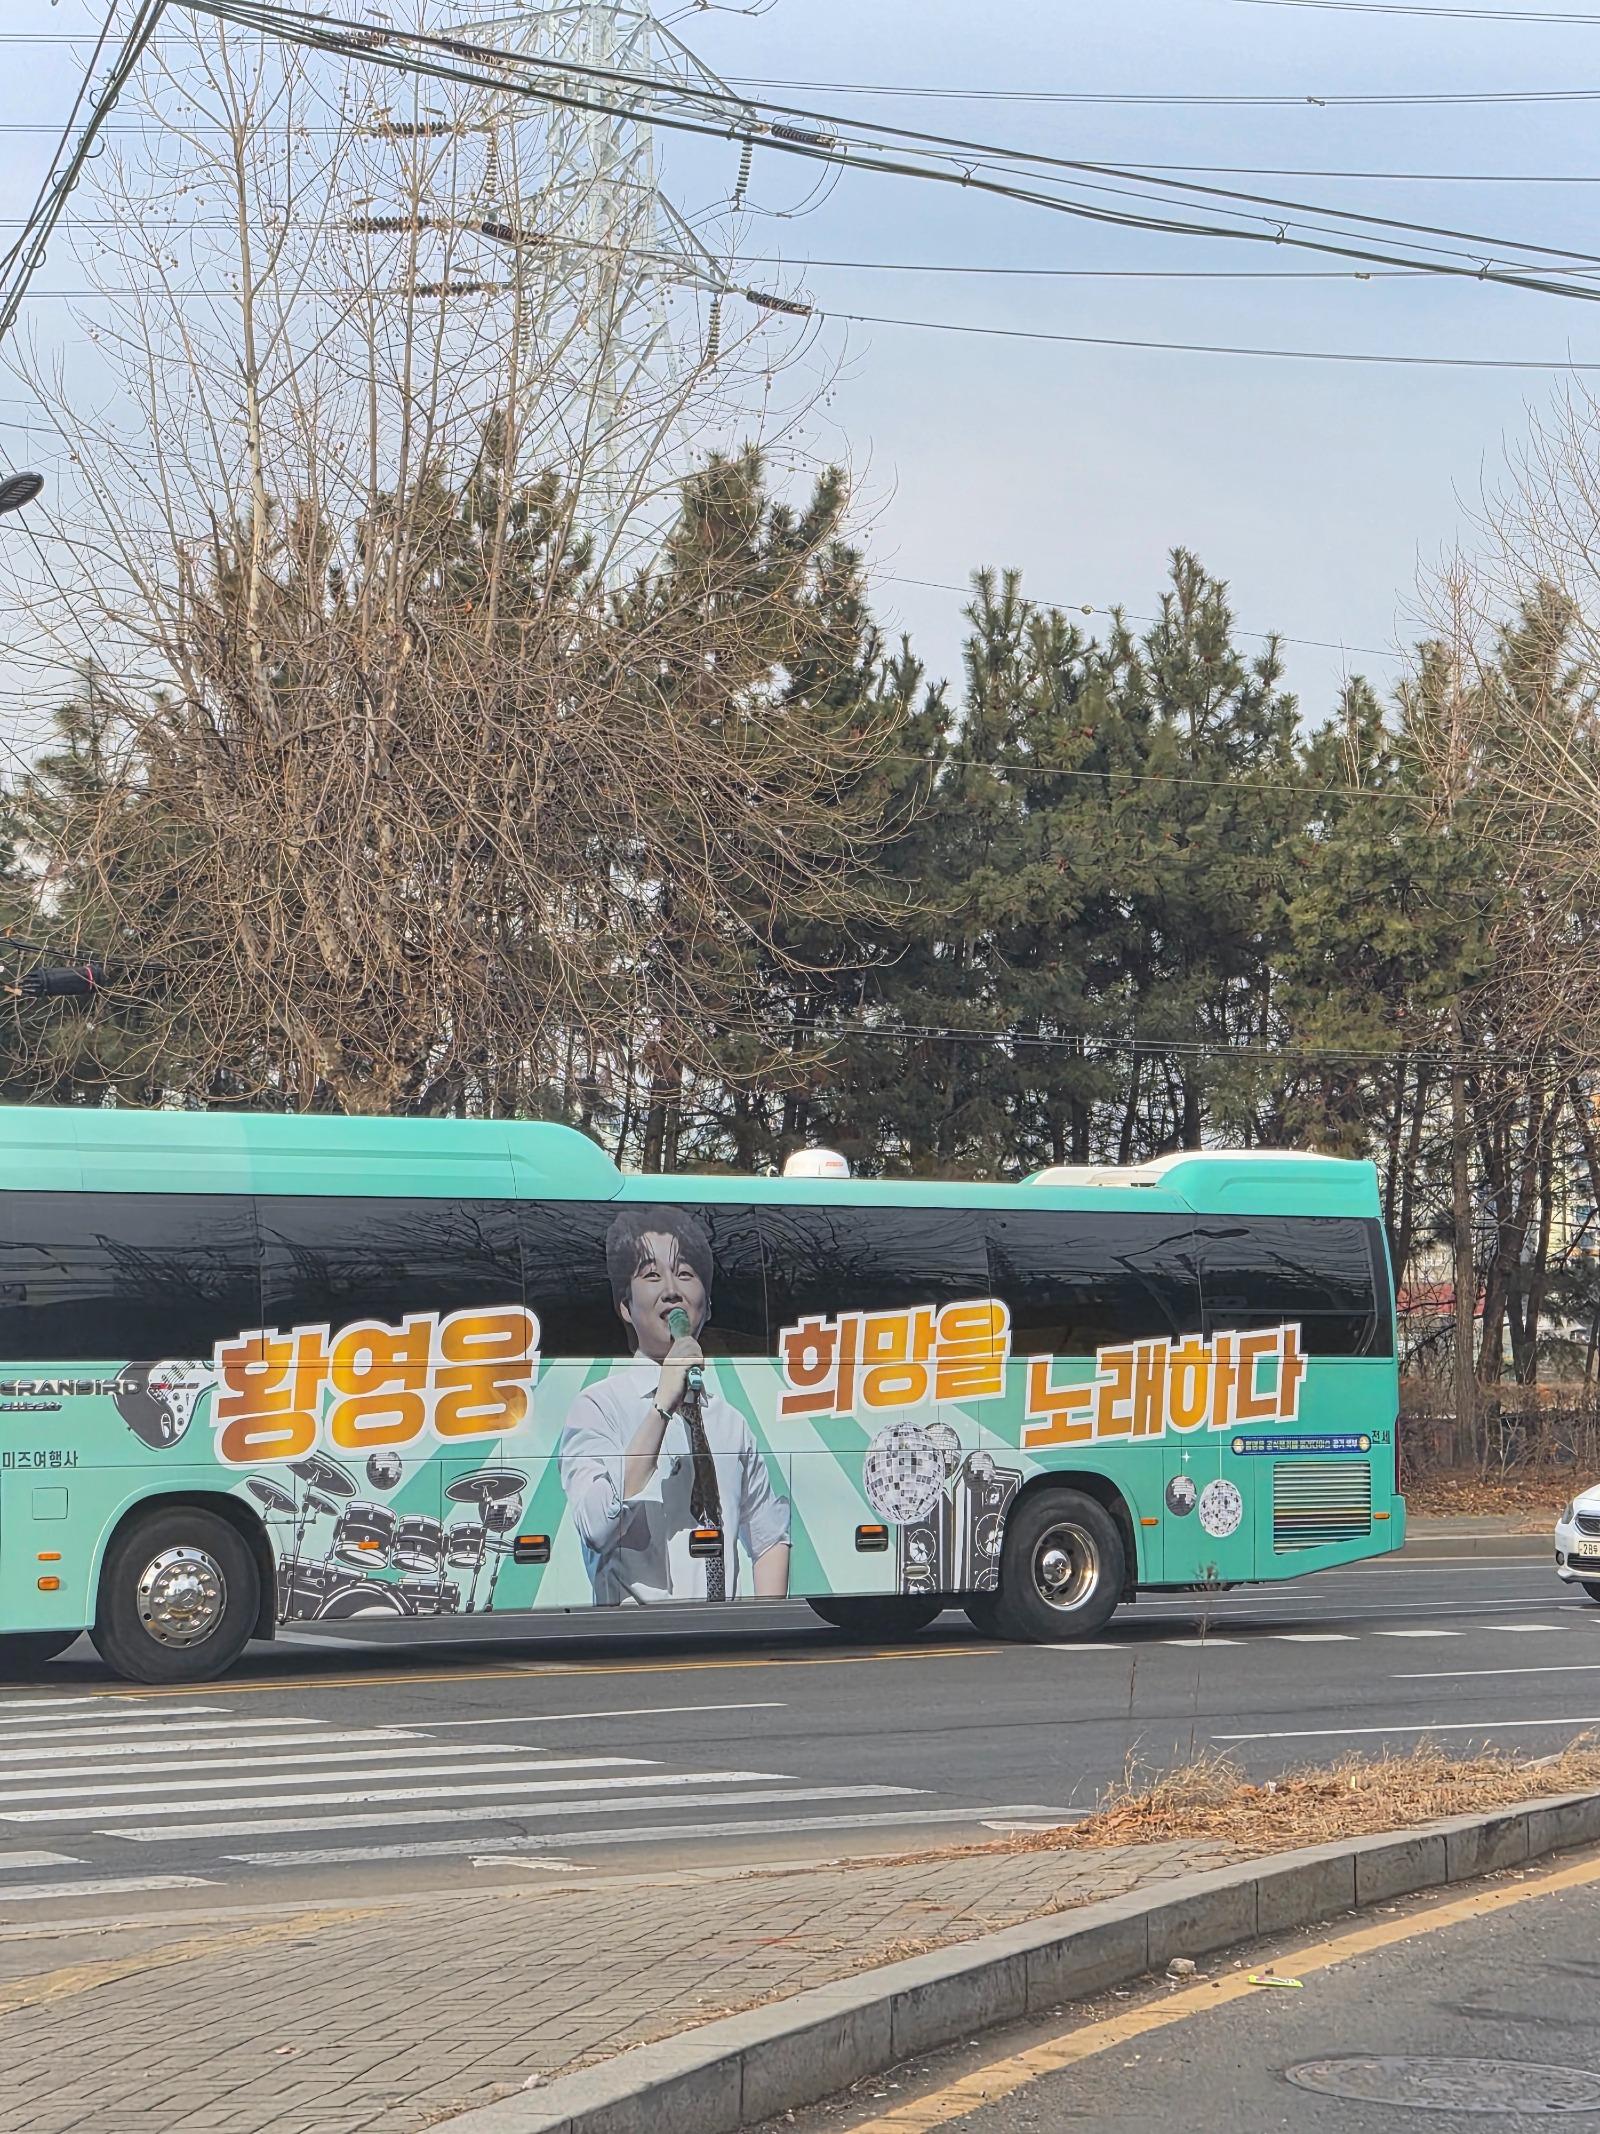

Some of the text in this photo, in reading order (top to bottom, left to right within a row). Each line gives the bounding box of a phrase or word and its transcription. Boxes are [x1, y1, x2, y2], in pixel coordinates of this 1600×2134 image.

[0, 1379, 141, 1396] GRANBIRD
[213, 1301, 1009, 1467] 황영웅 희망을
[1022, 1325, 1306, 1450] 노래하다
[2, 1450, 79, 1469] 미즈여행사
